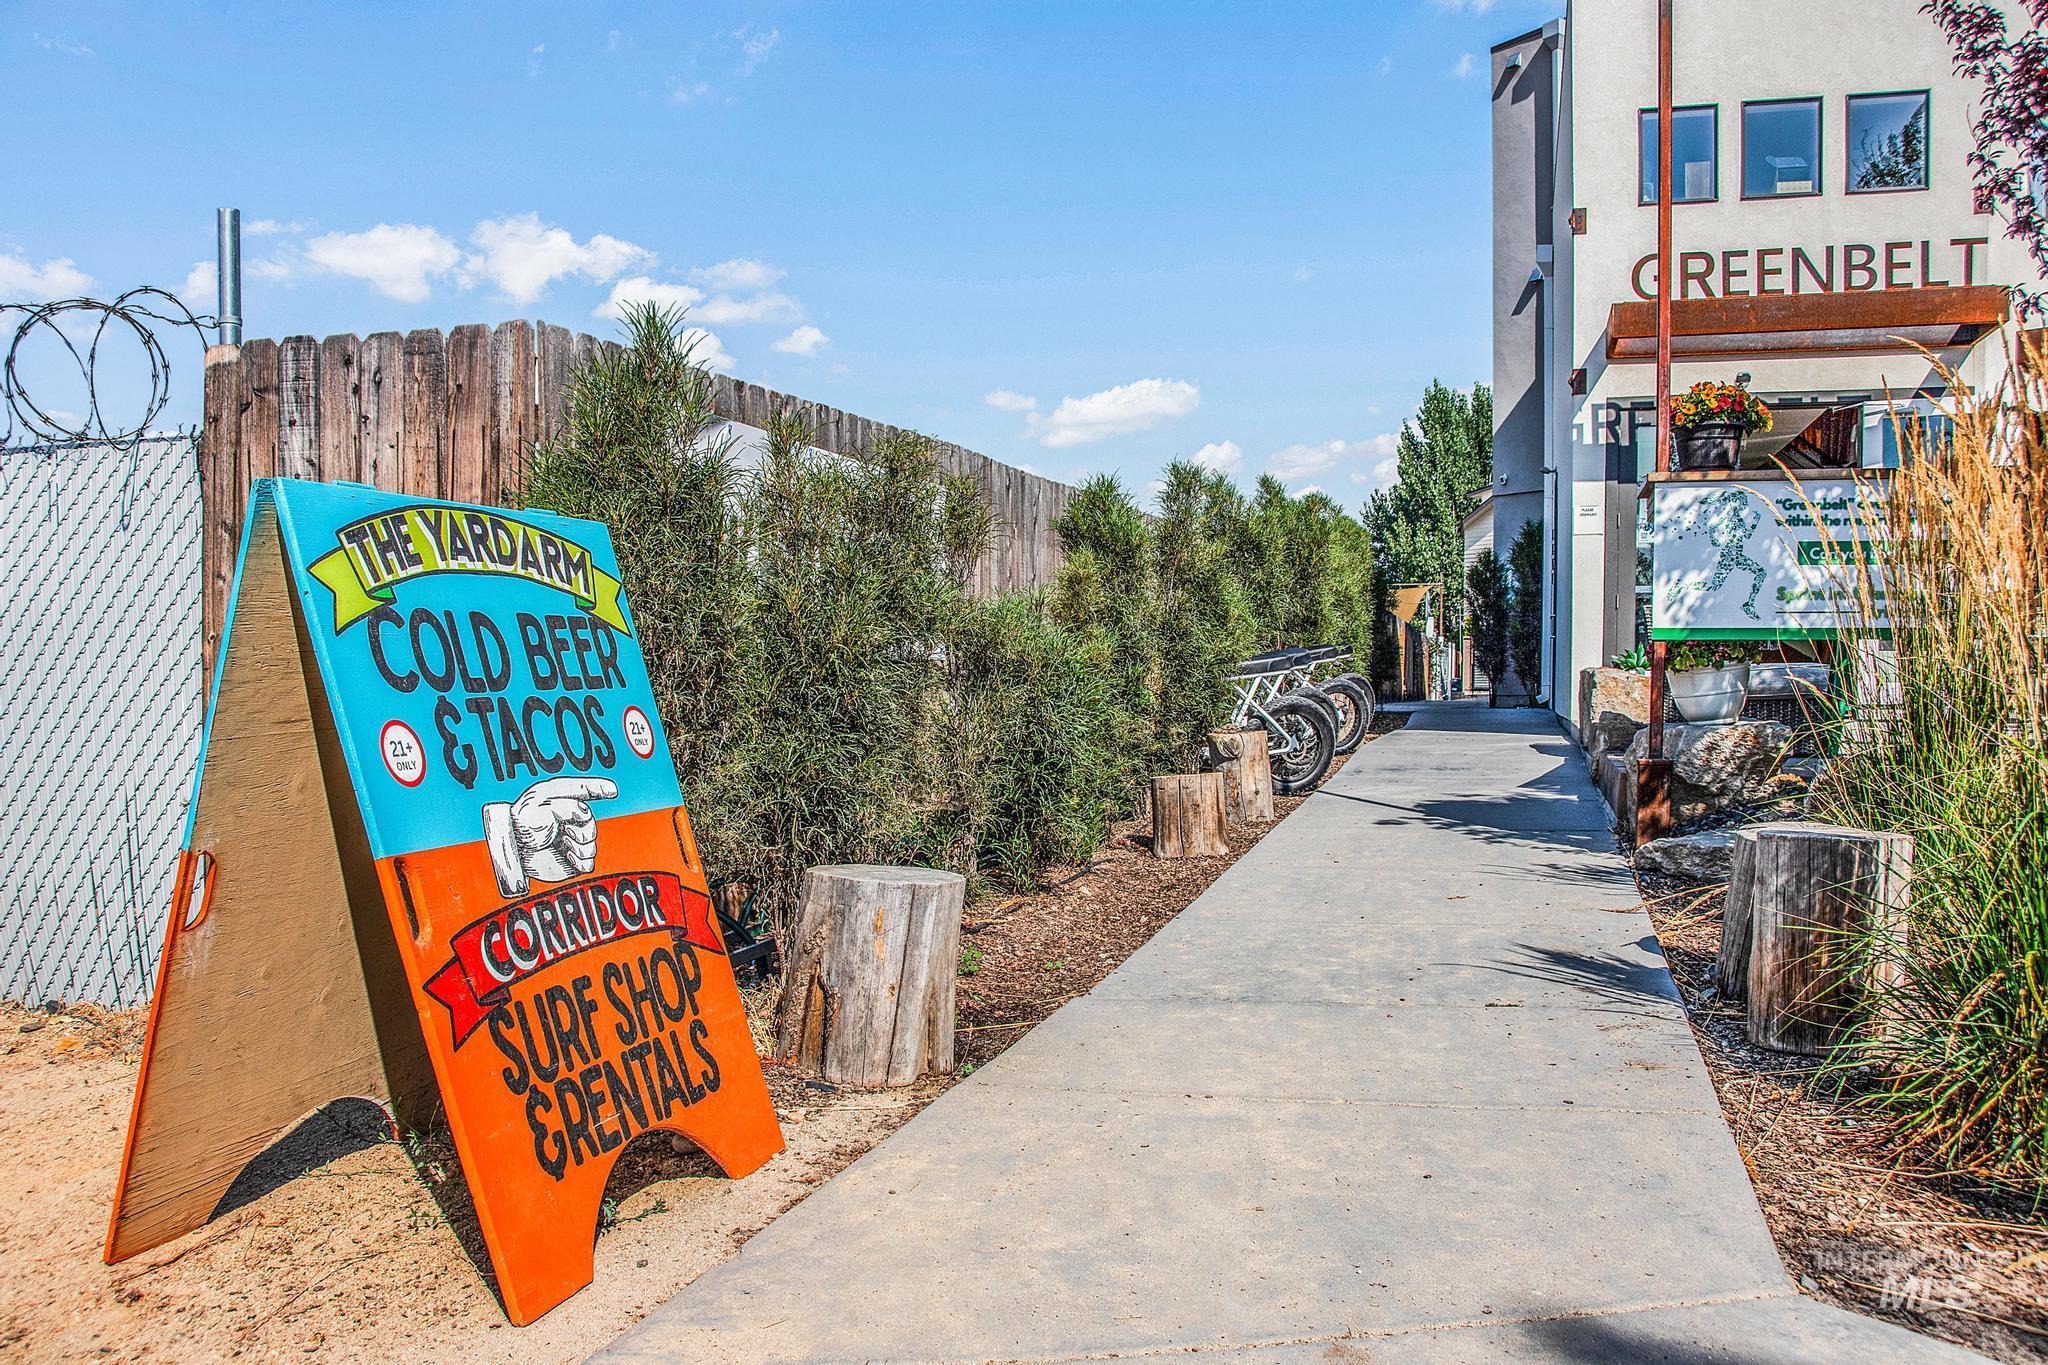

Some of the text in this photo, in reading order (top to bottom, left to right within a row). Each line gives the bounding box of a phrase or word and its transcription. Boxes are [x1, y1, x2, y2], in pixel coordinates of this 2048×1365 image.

[1631, 237, 1989, 300] GREENBELT
[344, 509, 593, 598] THE YARDARM
[367, 604, 627, 694] COLD BEER
[389, 739, 413, 758] 21+
[629, 721, 646, 735] 21+
[634, 738, 649, 746] ONLY
[396, 760, 418, 771] ONLY
[480, 875, 667, 983] CORRIDOR
[487, 943, 703, 1096] SURF SHOP
